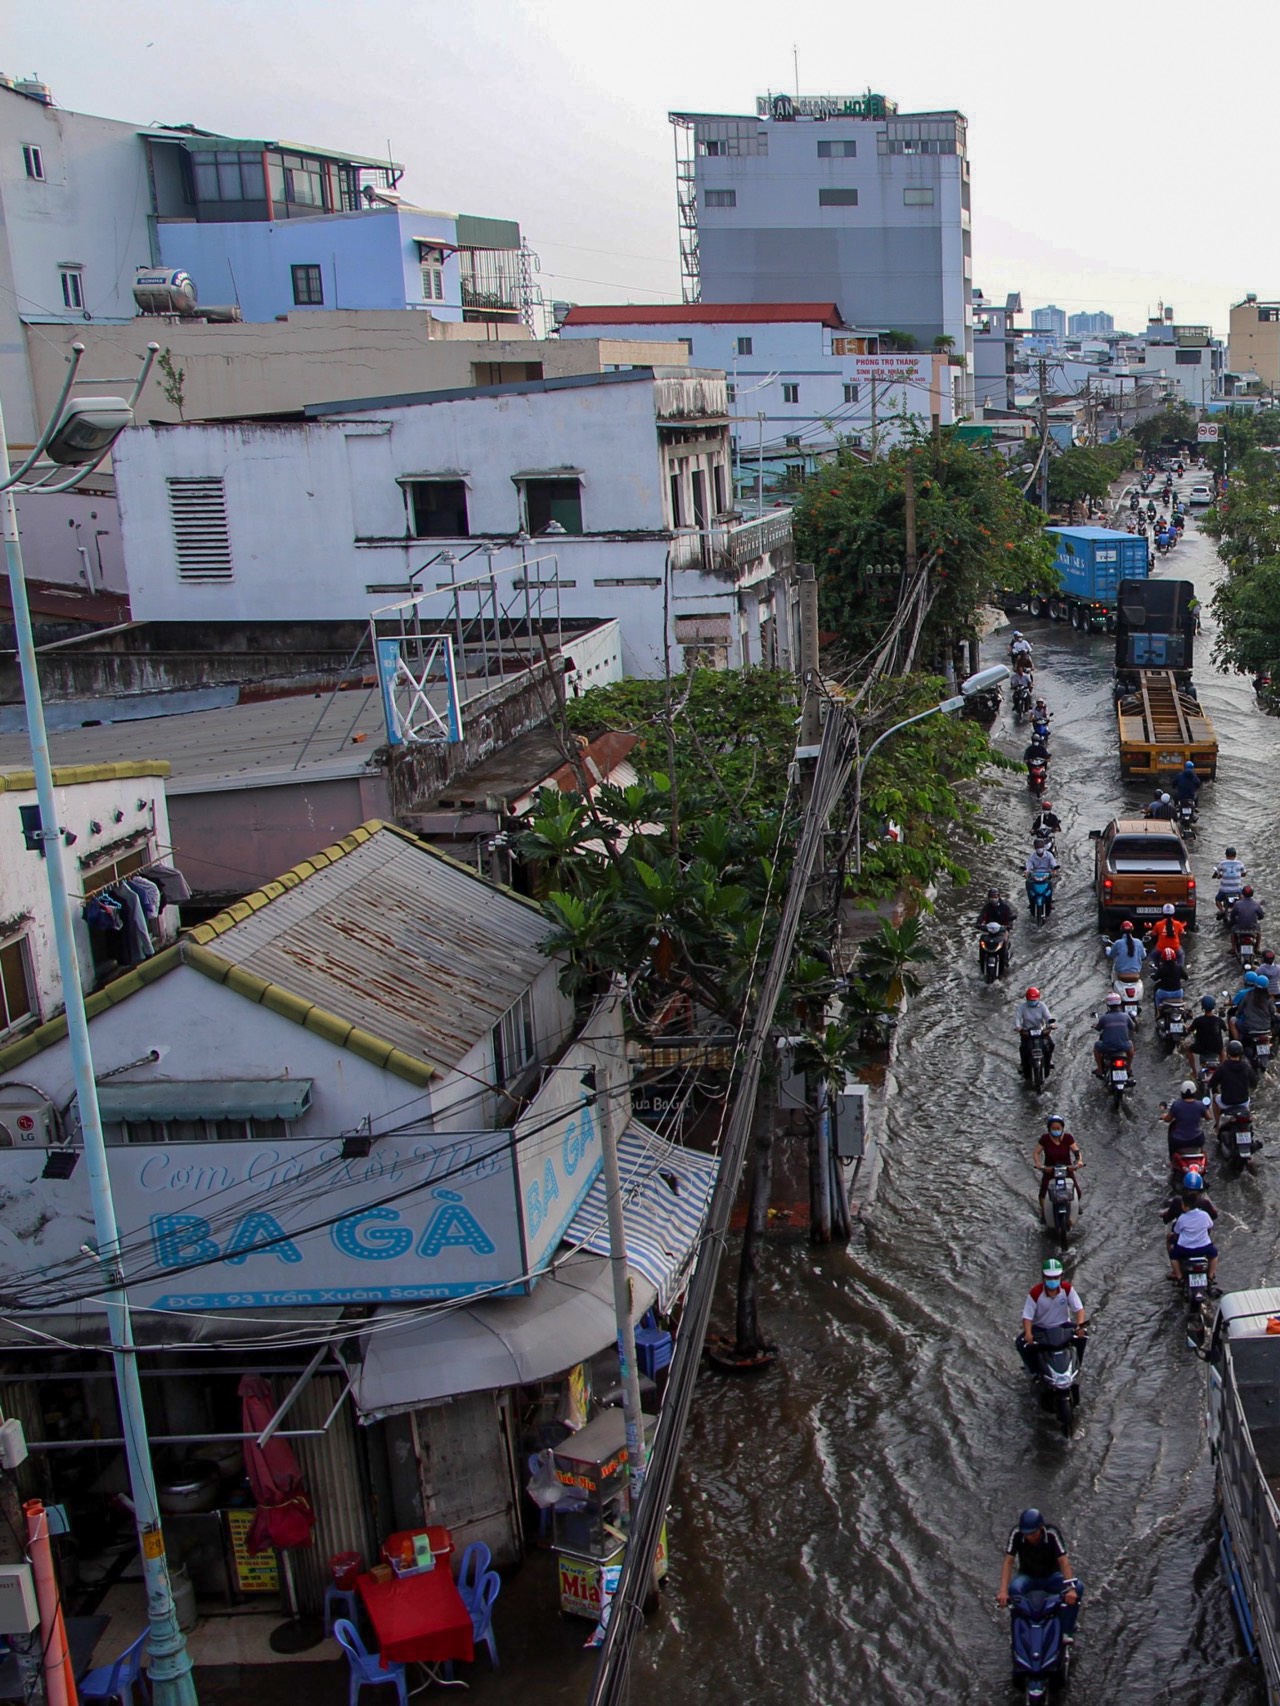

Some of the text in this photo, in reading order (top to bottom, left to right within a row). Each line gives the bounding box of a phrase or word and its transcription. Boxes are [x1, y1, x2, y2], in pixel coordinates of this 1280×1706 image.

[845, 100, 886, 115] HOTEL
[21, 1133, 35, 1142] LG
[139, 1152, 237, 1192] Cơm
[526, 1156, 560, 1241] BA
[149, 1213, 303, 1268] BA
[331, 1188, 496, 1263] GÀ
[167, 1296, 207, 1308] ĐC
[227, 1295, 255, 1305] 93
[319, 1287, 383, 1302] Xuân
[390, 1286, 449, 1300] Soạn
